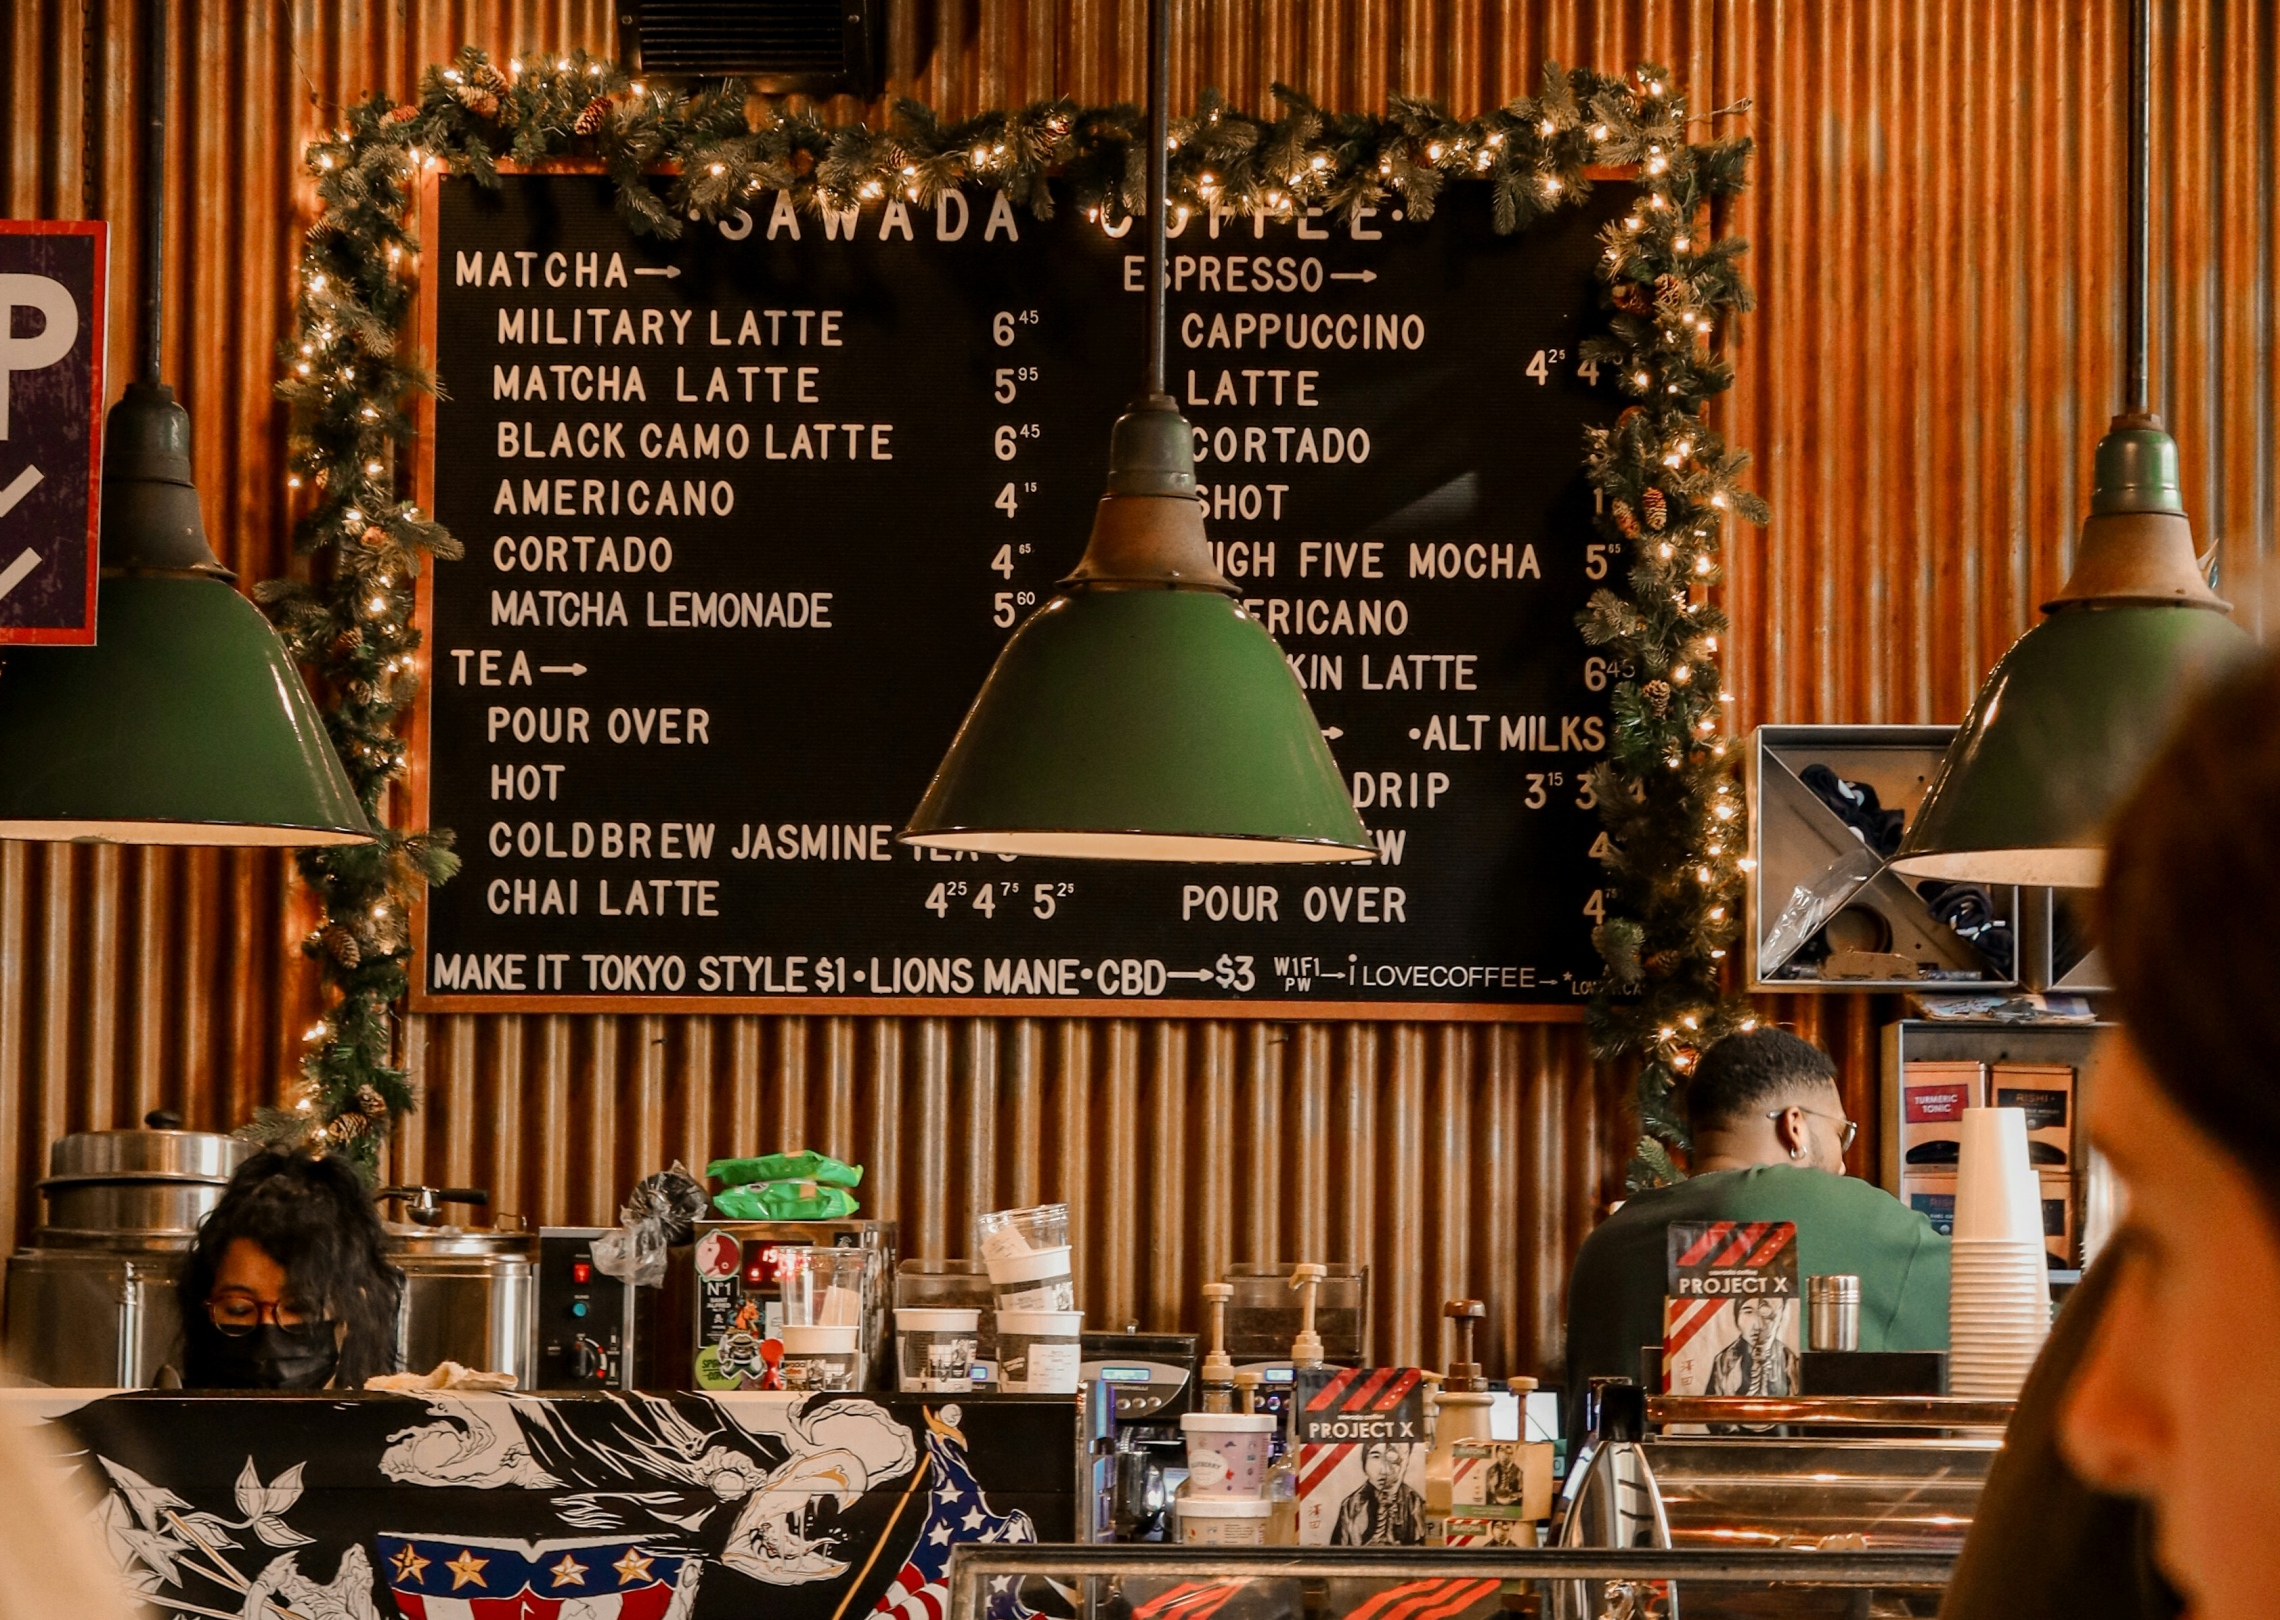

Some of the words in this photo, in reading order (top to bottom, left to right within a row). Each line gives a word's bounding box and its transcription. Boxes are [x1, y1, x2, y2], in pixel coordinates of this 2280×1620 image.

[457, 251, 627, 287] MATCHA
[499, 308, 692, 345] MILITARY
[711, 310, 842, 346] LATTE
[1182, 313, 1424, 349] CAPPUCCINO
[494, 365, 646, 401] MATCHA
[677, 367, 819, 402] LATTE
[1188, 370, 1318, 406] LATTE
[498, 422, 625, 458] BLACK
[640, 423, 749, 459] CAMO
[766, 424, 893, 460] LATTE
[1194, 427, 1370, 463] CORTADO
[494, 479, 734, 516] AMERICANO
[1199, 485, 1289, 519] SHOT
[494, 536, 672, 572] CORTADO
[1301, 542, 1384, 578] FIVE
[1410, 543, 1540, 579] MOCHA
[492, 590, 628, 626] MATCHA
[648, 592, 832, 627] LEMONADE
[451, 650, 532, 685] TEA
[1363, 655, 1477, 690] LATTE
[489, 707, 589, 743] POUR
[608, 708, 709, 744] OVER
[1423, 715, 1490, 750] ALT
[1501, 716, 1604, 751] MILKS
[492, 765, 565, 800] HOT
[1353, 771, 1450, 809] DRIP
[489, 822, 715, 858] COLDBREW
[732, 824, 892, 860] JASMINE
[488, 879, 577, 914] CHAI
[600, 880, 719, 916] LATTE
[1183, 885, 1278, 921] POUR
[1304, 887, 1406, 922] OVER
[435, 953, 526, 990] MAKE
[538, 954, 570, 990] IT
[582, 955, 685, 991] TOKYO
[698, 956, 808, 992] STYLE
[871, 957, 974, 993] LIONS
[985, 958, 1080, 995] MANE
[1097, 959, 1166, 995] CBD
[1215, 953, 1255, 992] $3
[1285, 978, 1311, 991] PW
[1914, 1094, 1958, 1105] TURMERIC
[1922, 1104, 1952, 1114] TONIC
[1679, 1277, 1768, 1294] PROJECT
[1774, 1277, 1788, 1293] X
[1309, 1421, 1394, 1439] PROJECT
[1400, 1421, 1414, 1438] X
